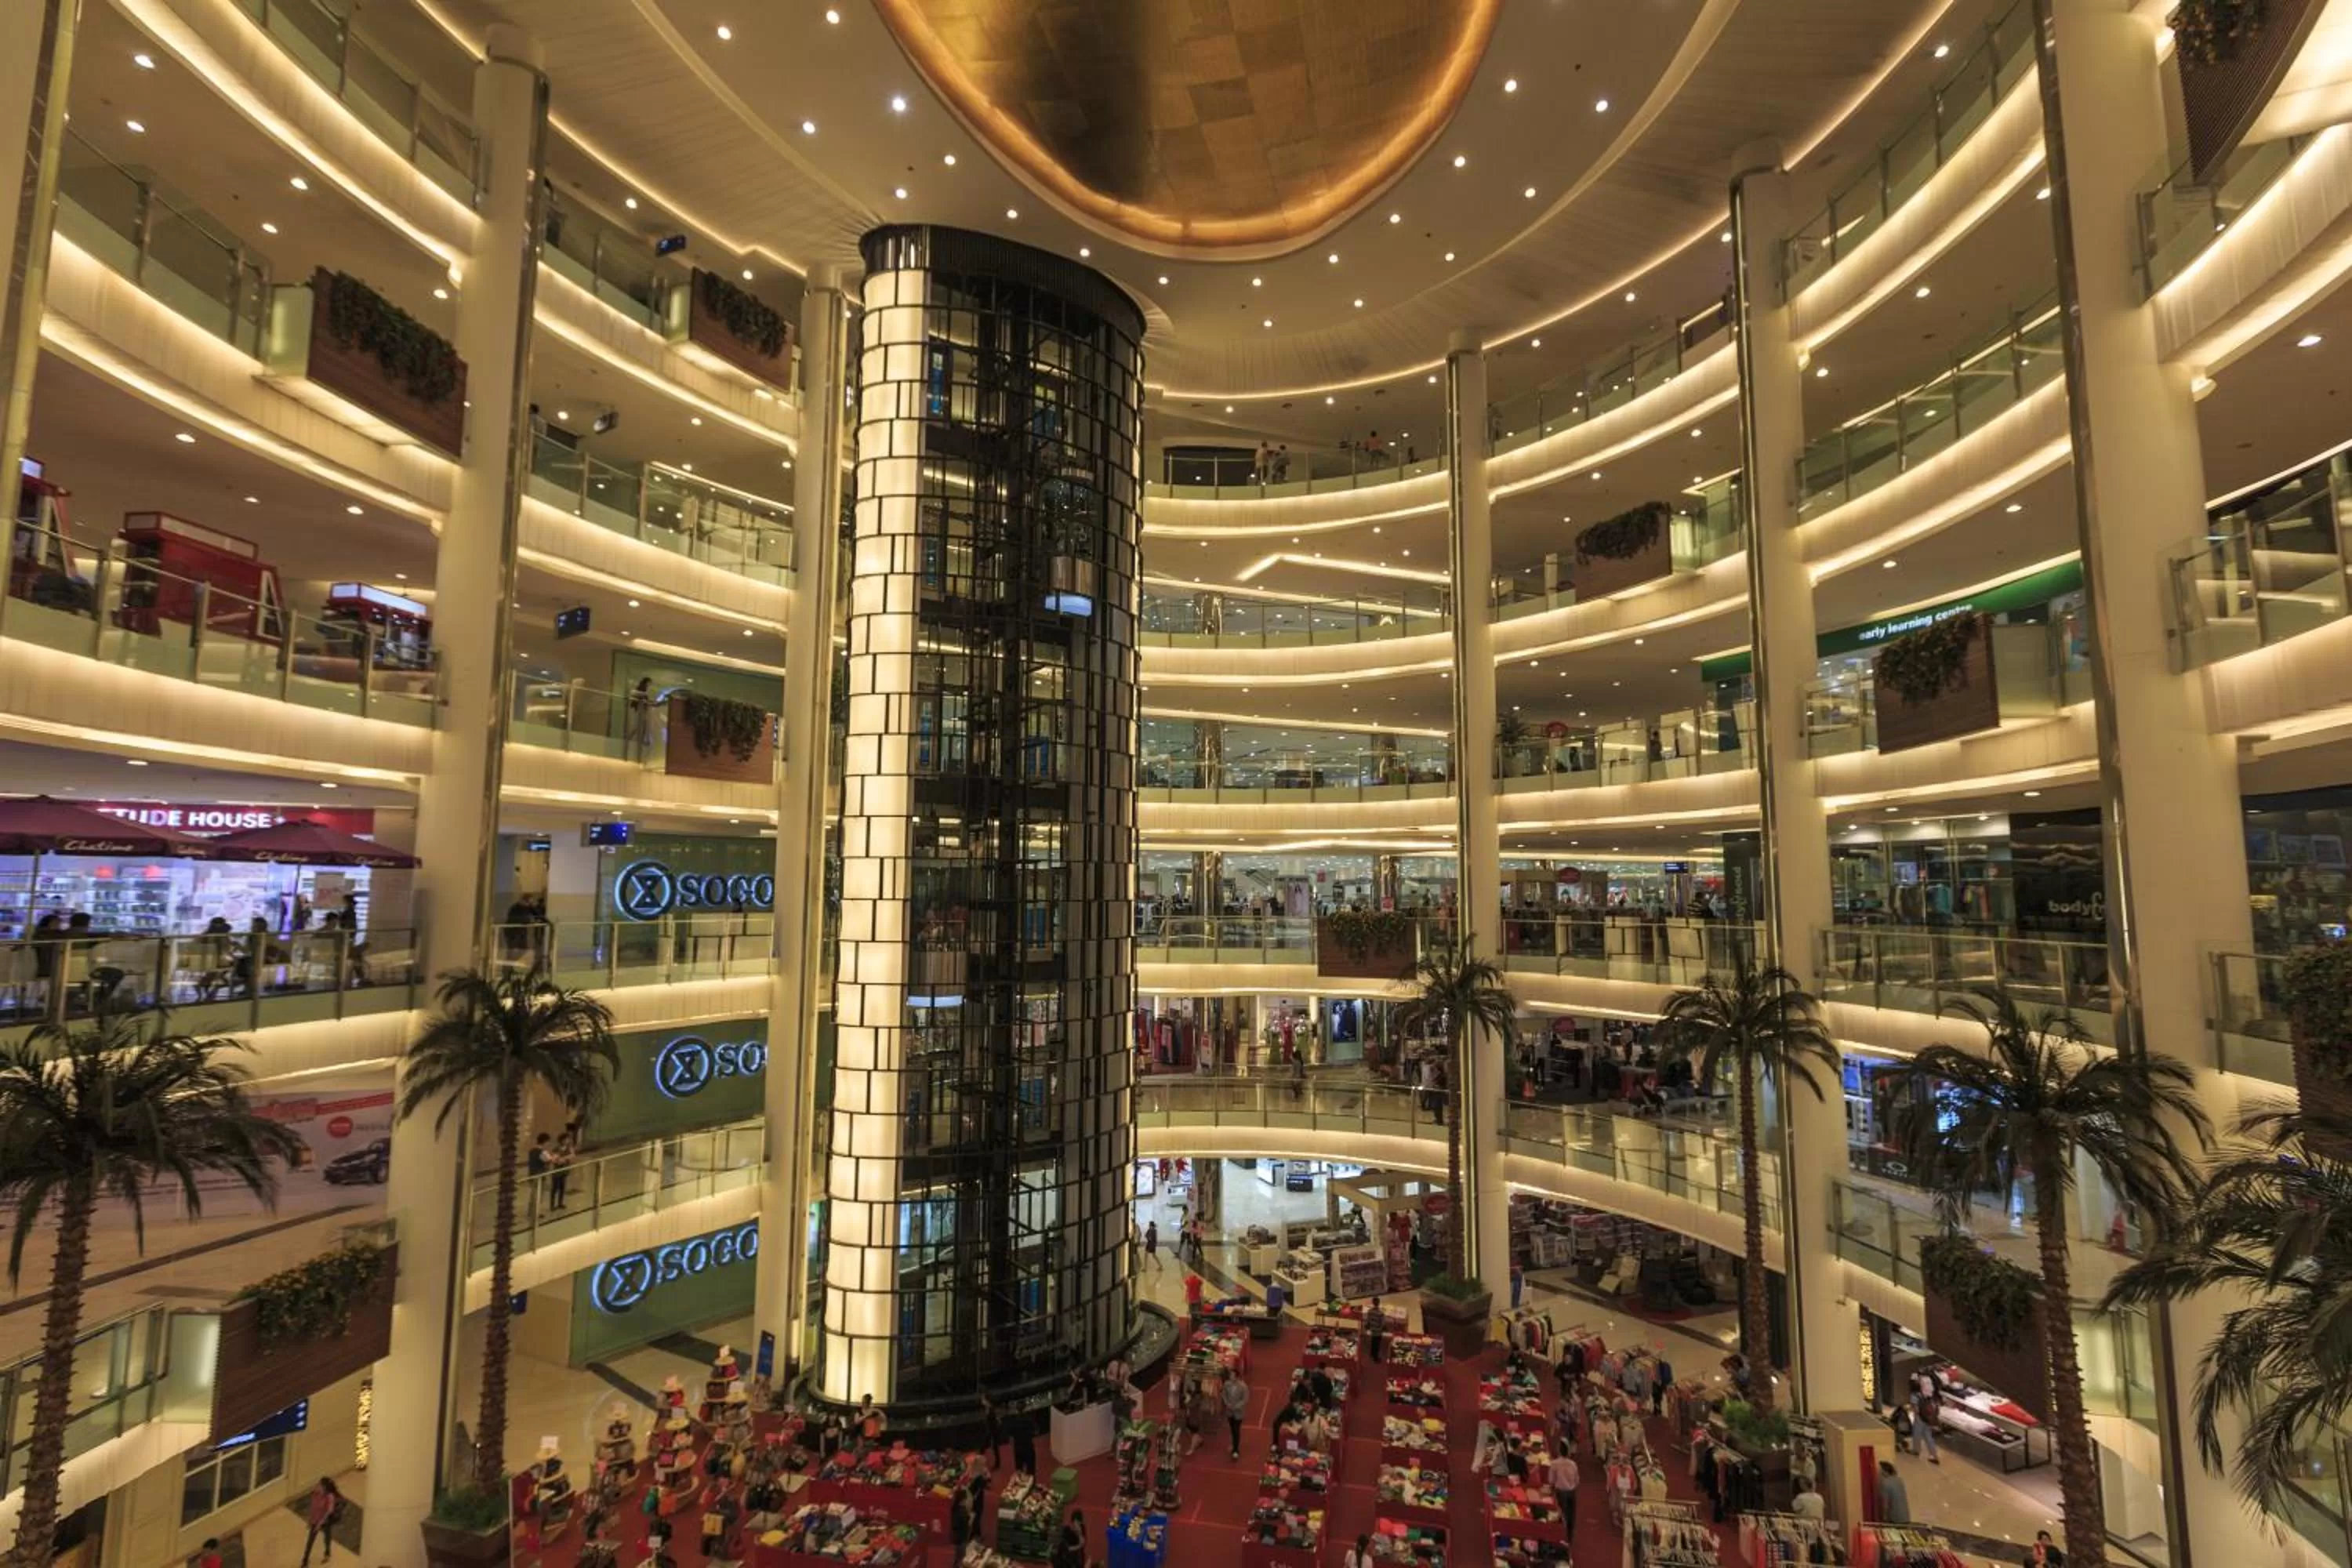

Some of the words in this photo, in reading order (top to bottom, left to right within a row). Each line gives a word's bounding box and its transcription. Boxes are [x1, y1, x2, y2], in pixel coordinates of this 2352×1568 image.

[1859, 626, 1886, 641] early
[1887, 615, 1933, 634] learning
[188, 811, 272, 829] HOUSE
[676, 872, 775, 907] SOGO
[713, 1040, 768, 1079] SO
[656, 1225, 759, 1284] SOGO
